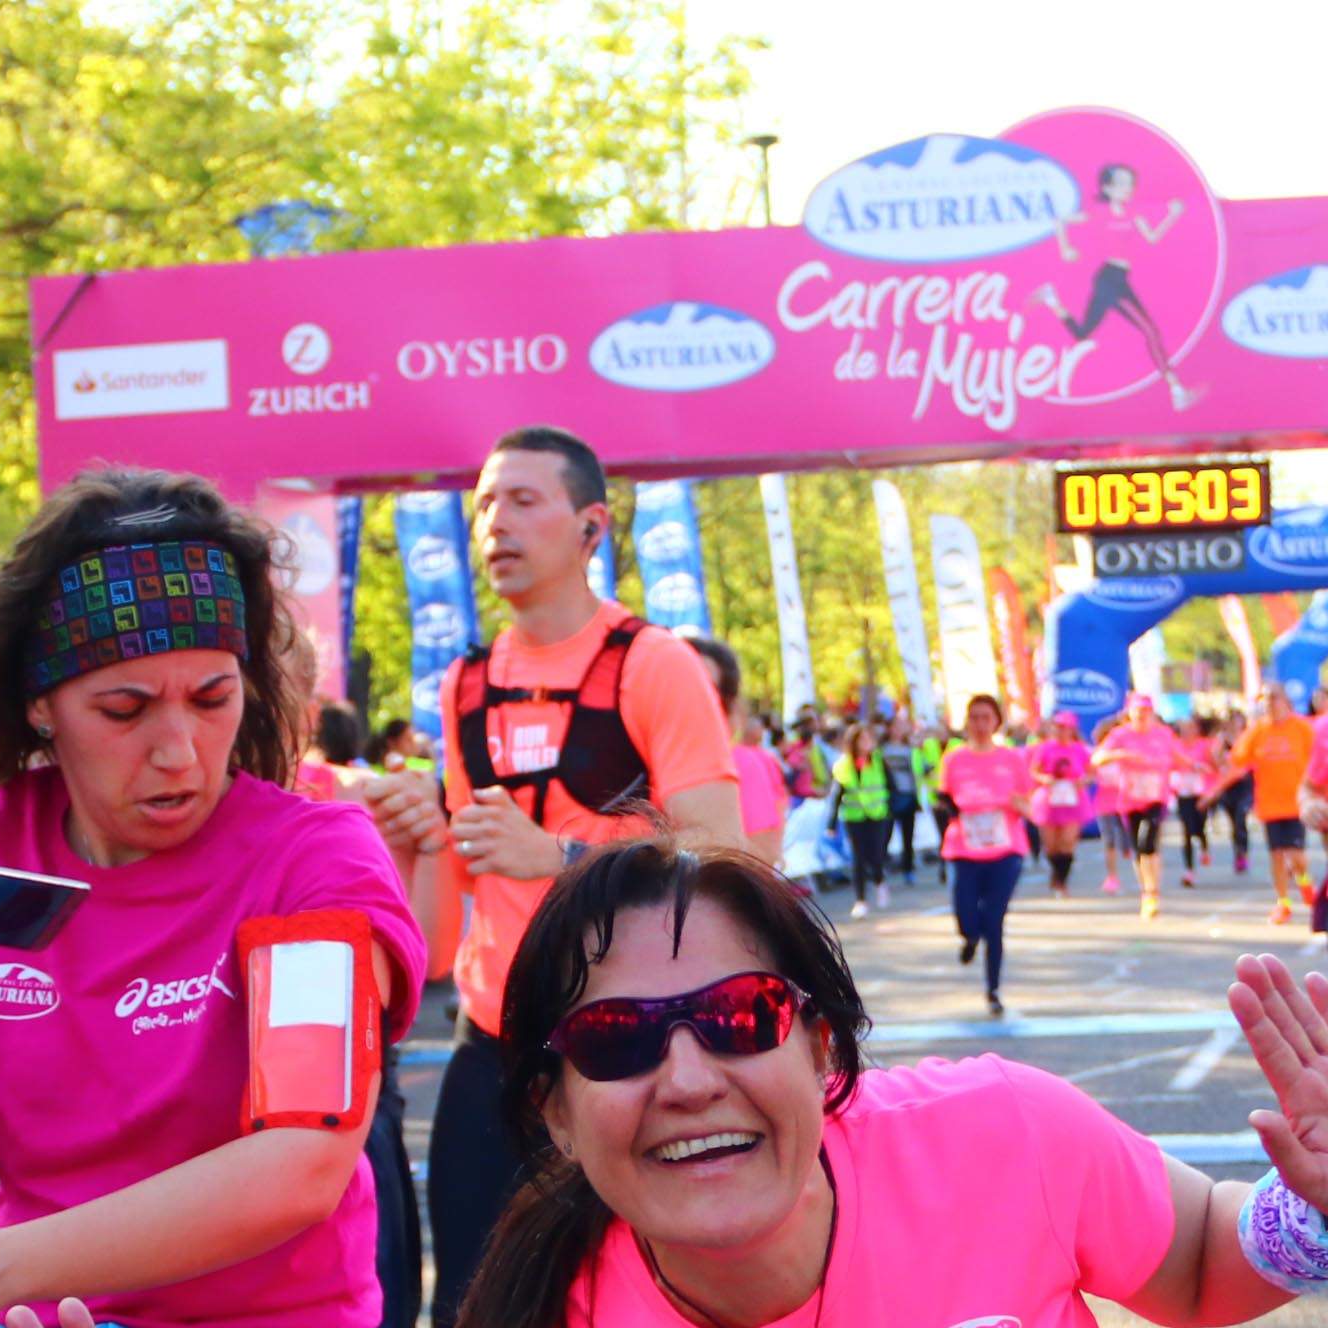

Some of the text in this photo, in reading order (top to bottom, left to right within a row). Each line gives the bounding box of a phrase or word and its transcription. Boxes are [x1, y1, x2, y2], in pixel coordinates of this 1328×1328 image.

[824, 187, 1057, 236] ASTURIANA
[776, 261, 1009, 333] Carrera
[396, 334, 568, 380] OYSHO
[602, 337, 761, 372] ASTURIANA
[834, 313, 1097, 431] de la Mujer
[99, 367, 209, 392] Santander
[248, 382, 370, 417] ZURICH
[1095, 535, 1243, 574] OYSHO
[146, 974, 209, 1008] asics
